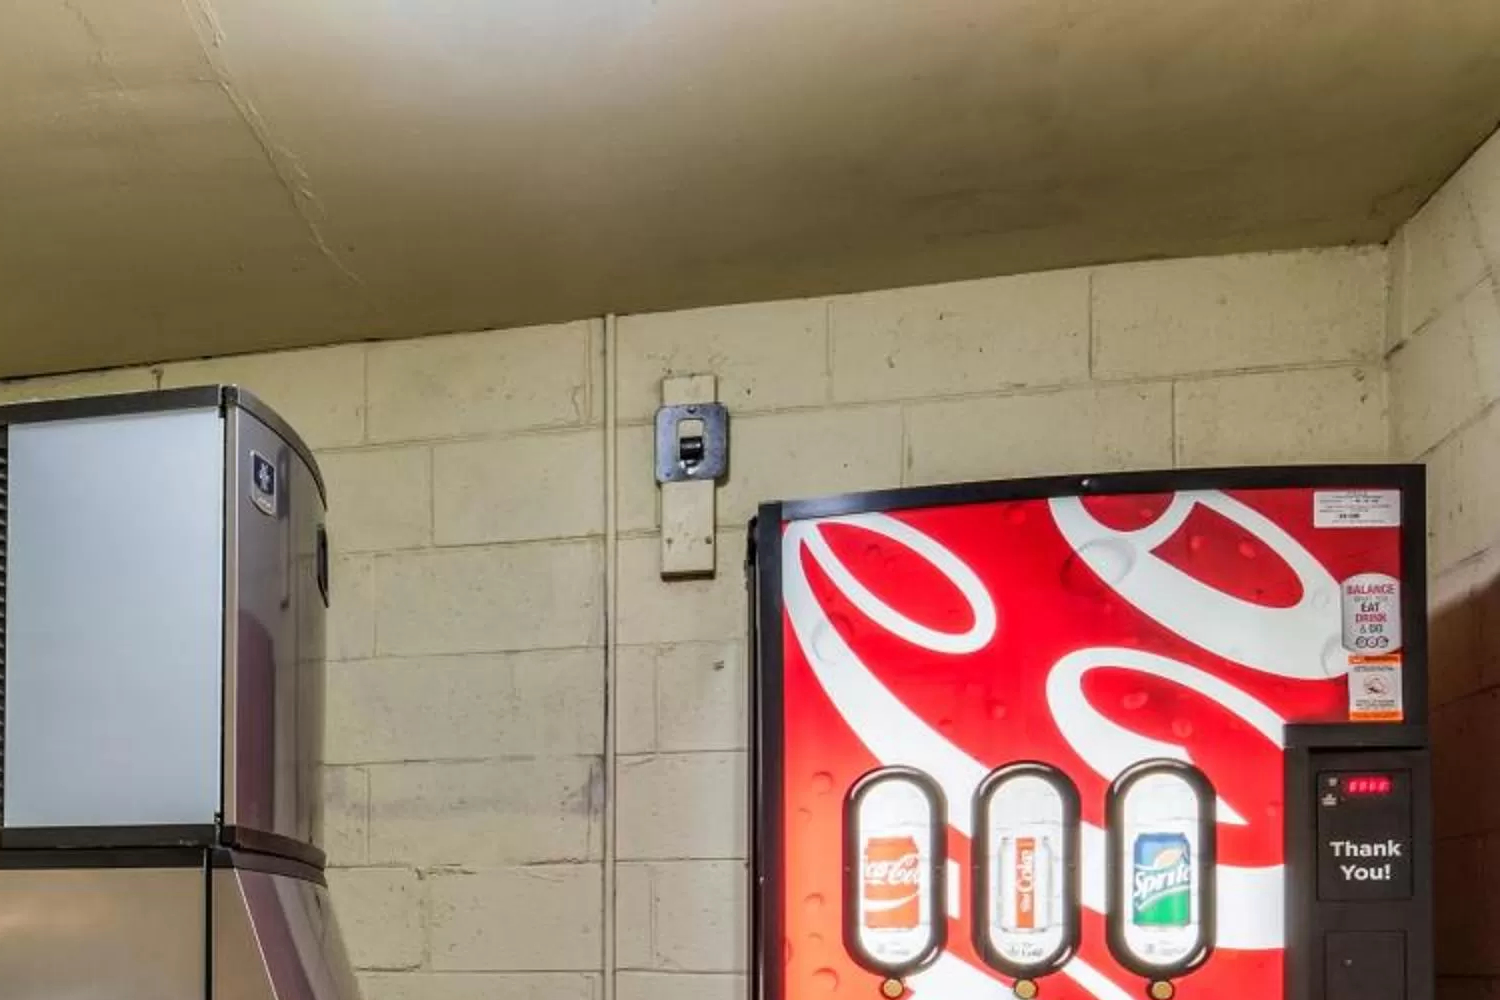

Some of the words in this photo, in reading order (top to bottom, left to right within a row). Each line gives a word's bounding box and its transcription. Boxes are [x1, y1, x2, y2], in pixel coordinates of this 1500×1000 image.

[1346, 584, 1397, 595] BALANCE
[1361, 602, 1380, 613] EAT
[1355, 613, 1388, 624] DRINK
[1329, 840, 1402, 857] Thank
[1340, 864, 1391, 881] You!
